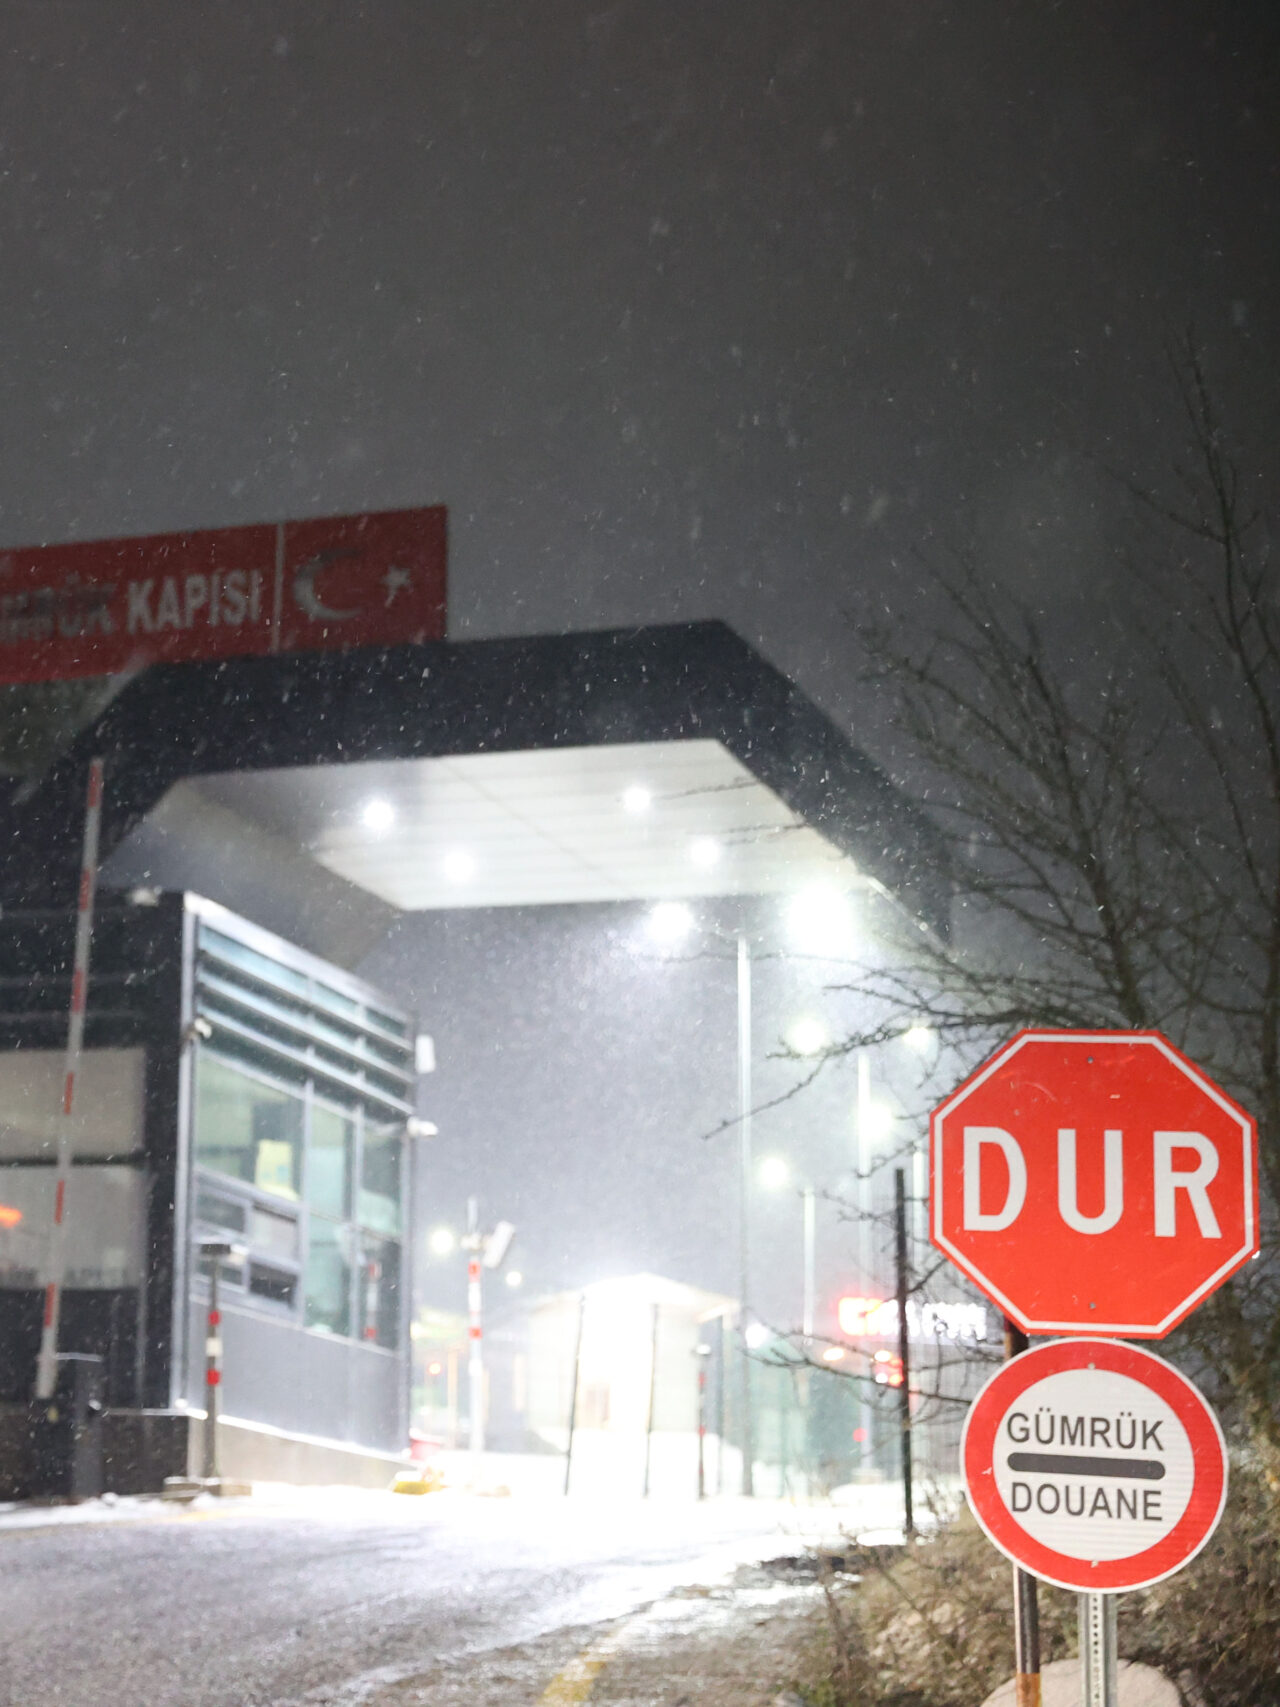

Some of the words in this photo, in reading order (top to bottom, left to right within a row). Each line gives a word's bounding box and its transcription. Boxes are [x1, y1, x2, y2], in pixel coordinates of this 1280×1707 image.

[125, 568, 263, 634] KAPISI
[963, 1126, 1222, 1239] DUR
[1006, 1407, 1164, 1451] GÜMRÜK
[1011, 1482, 1163, 1521] DOUANE
